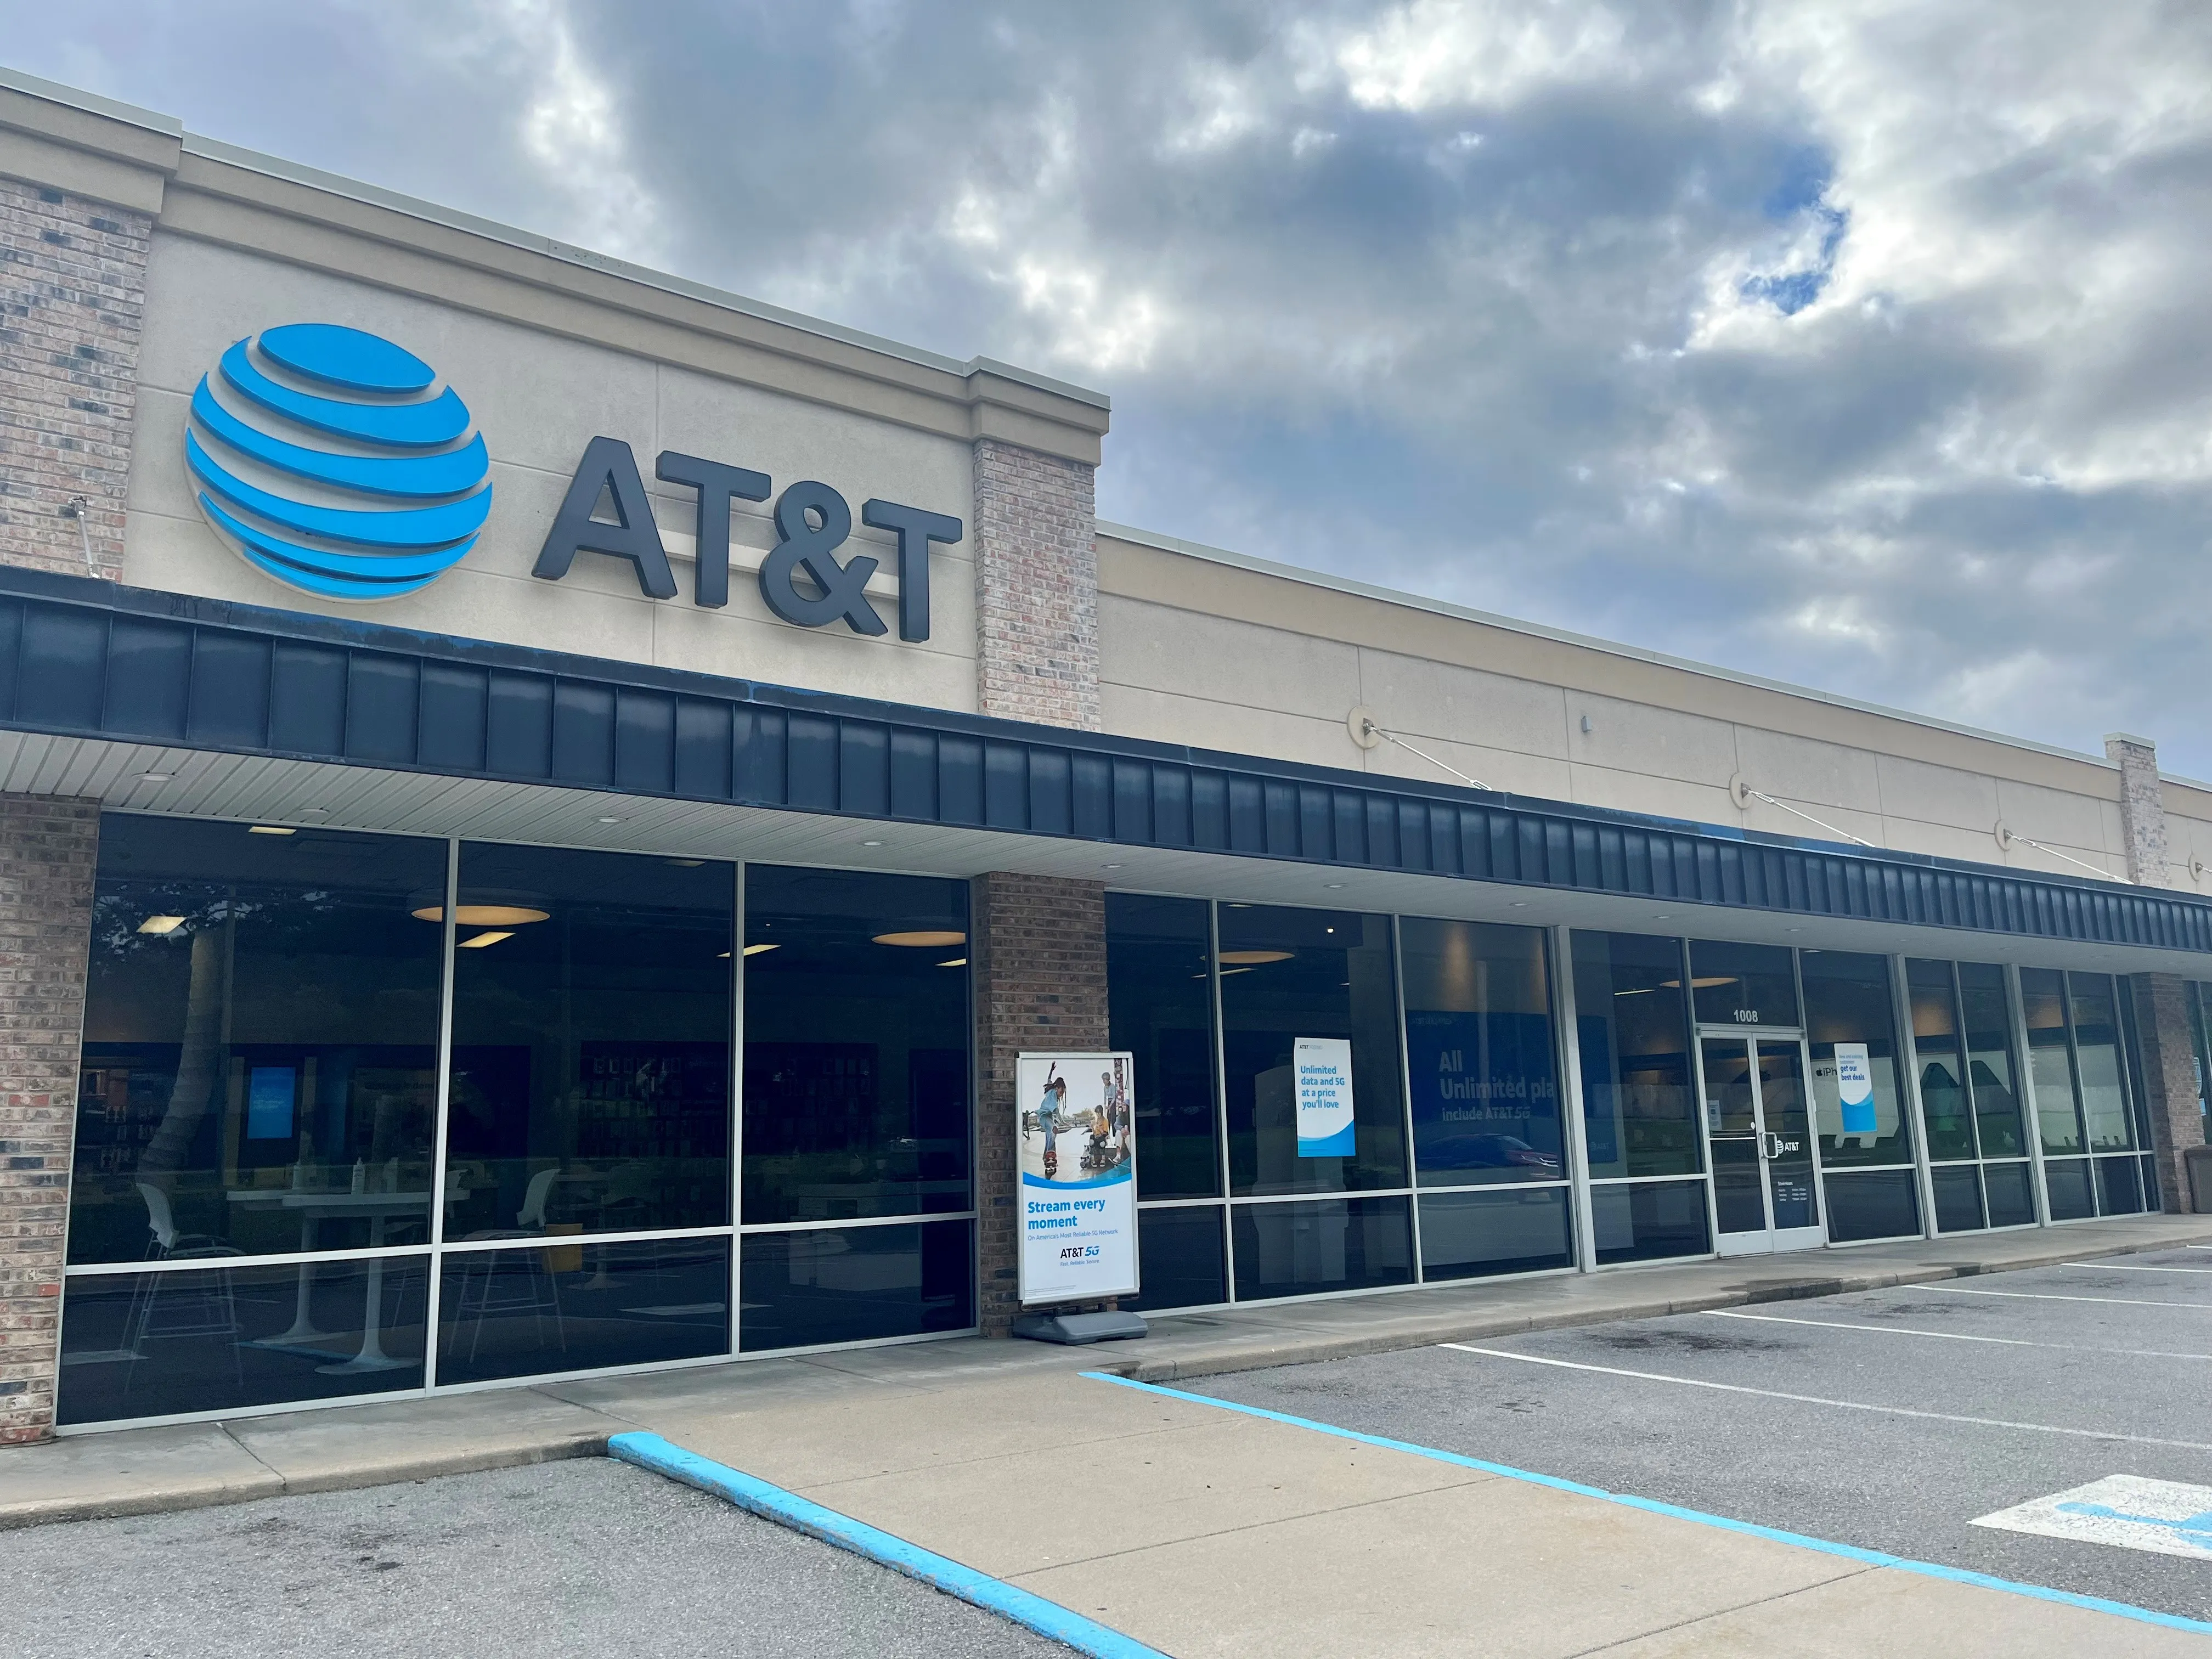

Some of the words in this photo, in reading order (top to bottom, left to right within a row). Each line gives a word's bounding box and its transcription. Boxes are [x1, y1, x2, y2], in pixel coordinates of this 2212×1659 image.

[531, 436, 963, 644] AT&T
[1734, 1009, 1758, 1023] 1008
[1439, 1049, 1463, 1072] All
[1301, 1065, 1336, 1074] Unlimited
[1840, 1065, 1848, 1073] get
[1301, 1076, 1318, 1085] data
[1320, 1077, 1334, 1085] and
[1335, 1077, 1345, 1086] 5G
[1440, 1076, 1526, 1099] Unlimited
[1301, 1088, 1310, 1097] at
[1318, 1088, 1336, 1099] price
[1302, 1099, 1322, 1110] you'll
[1324, 1099, 1339, 1108] love
[1442, 1107, 1482, 1121] include
[1485, 1106, 1513, 1120] AT&T
[1514, 1106, 1530, 1120] 5G
[1785, 1142, 1799, 1152] AT&T
[1028, 1201, 1070, 1214] Stream
[1074, 1199, 1105, 1212] every
[1028, 1215, 1078, 1230] moment
[1060, 1247, 1084, 1259] AT&T
[1085, 1246, 1100, 1256] 5G
